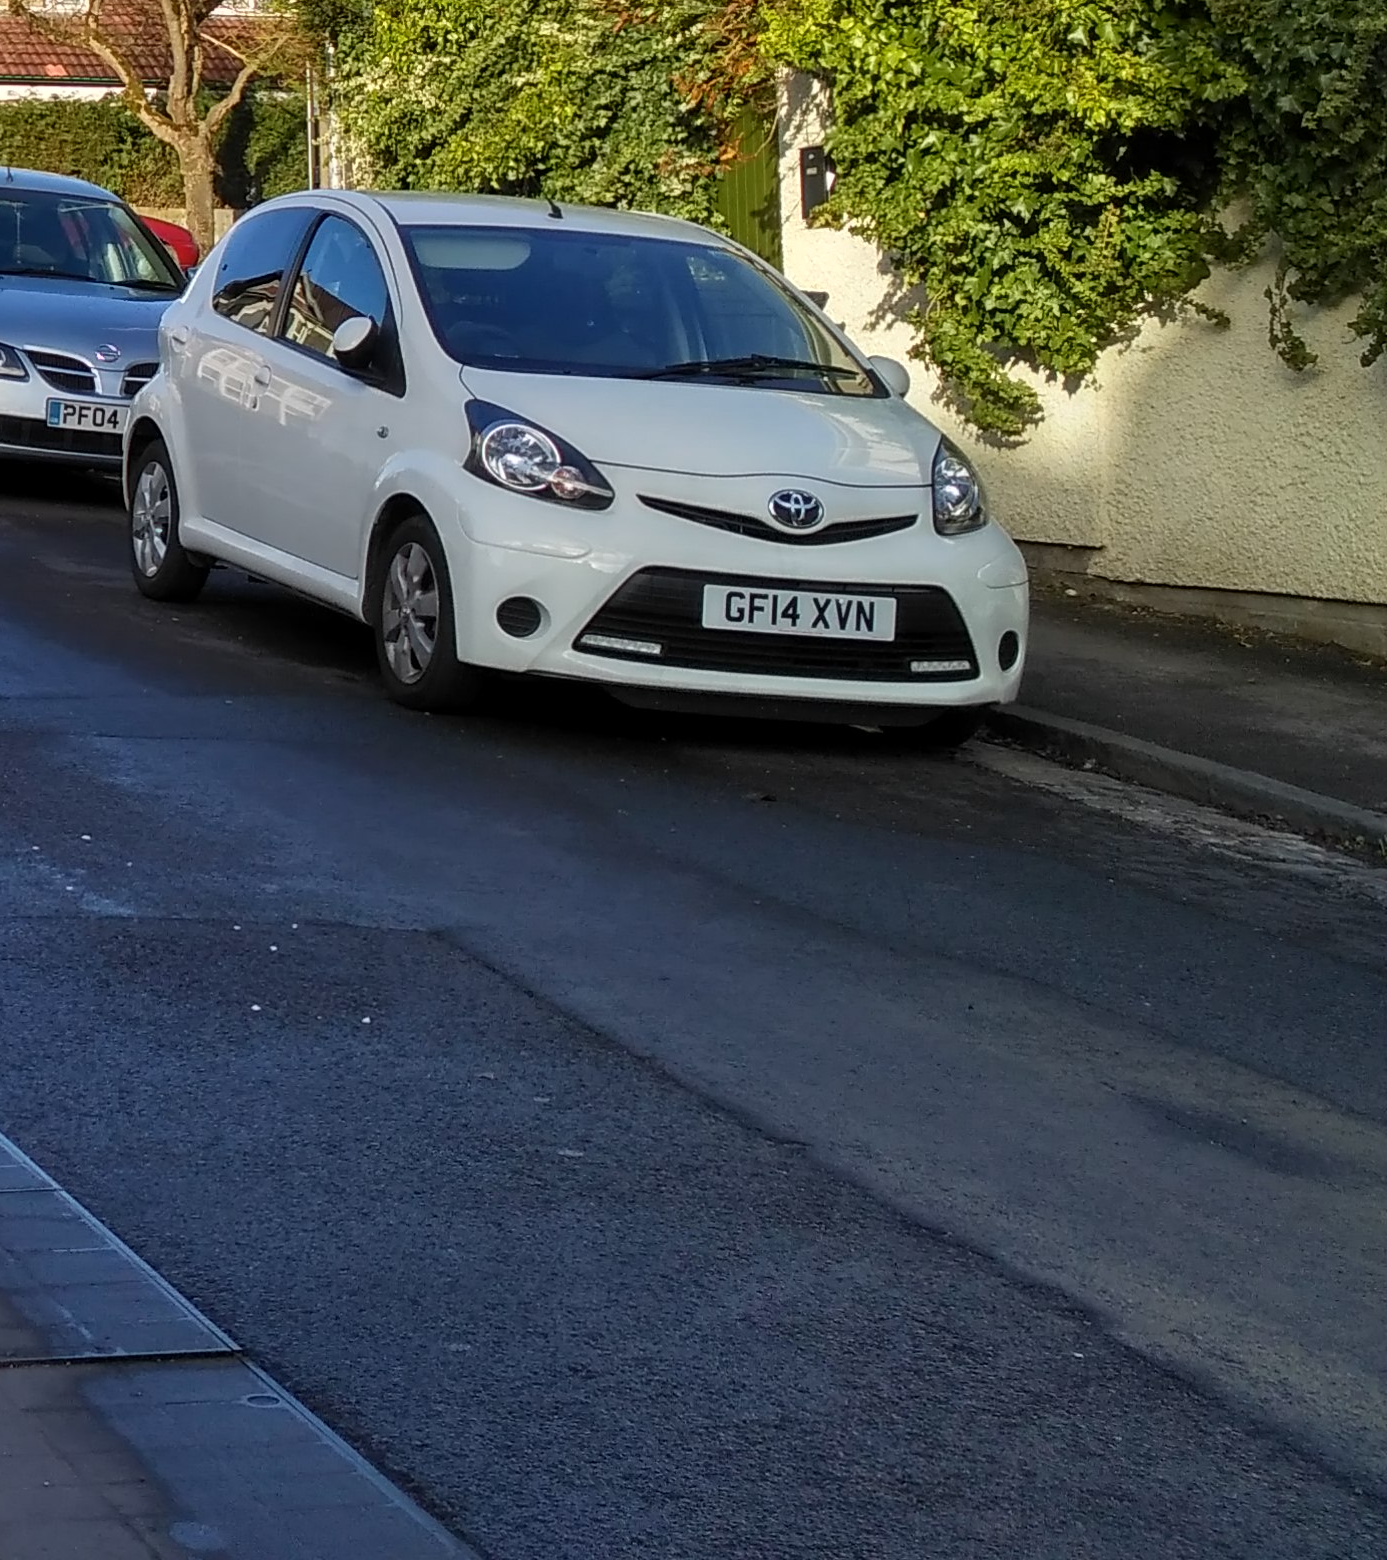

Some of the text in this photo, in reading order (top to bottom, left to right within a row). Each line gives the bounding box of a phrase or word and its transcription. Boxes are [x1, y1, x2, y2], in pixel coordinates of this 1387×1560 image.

[63, 403, 119, 429] PF04
[725, 591, 875, 632] GF14 XVN
